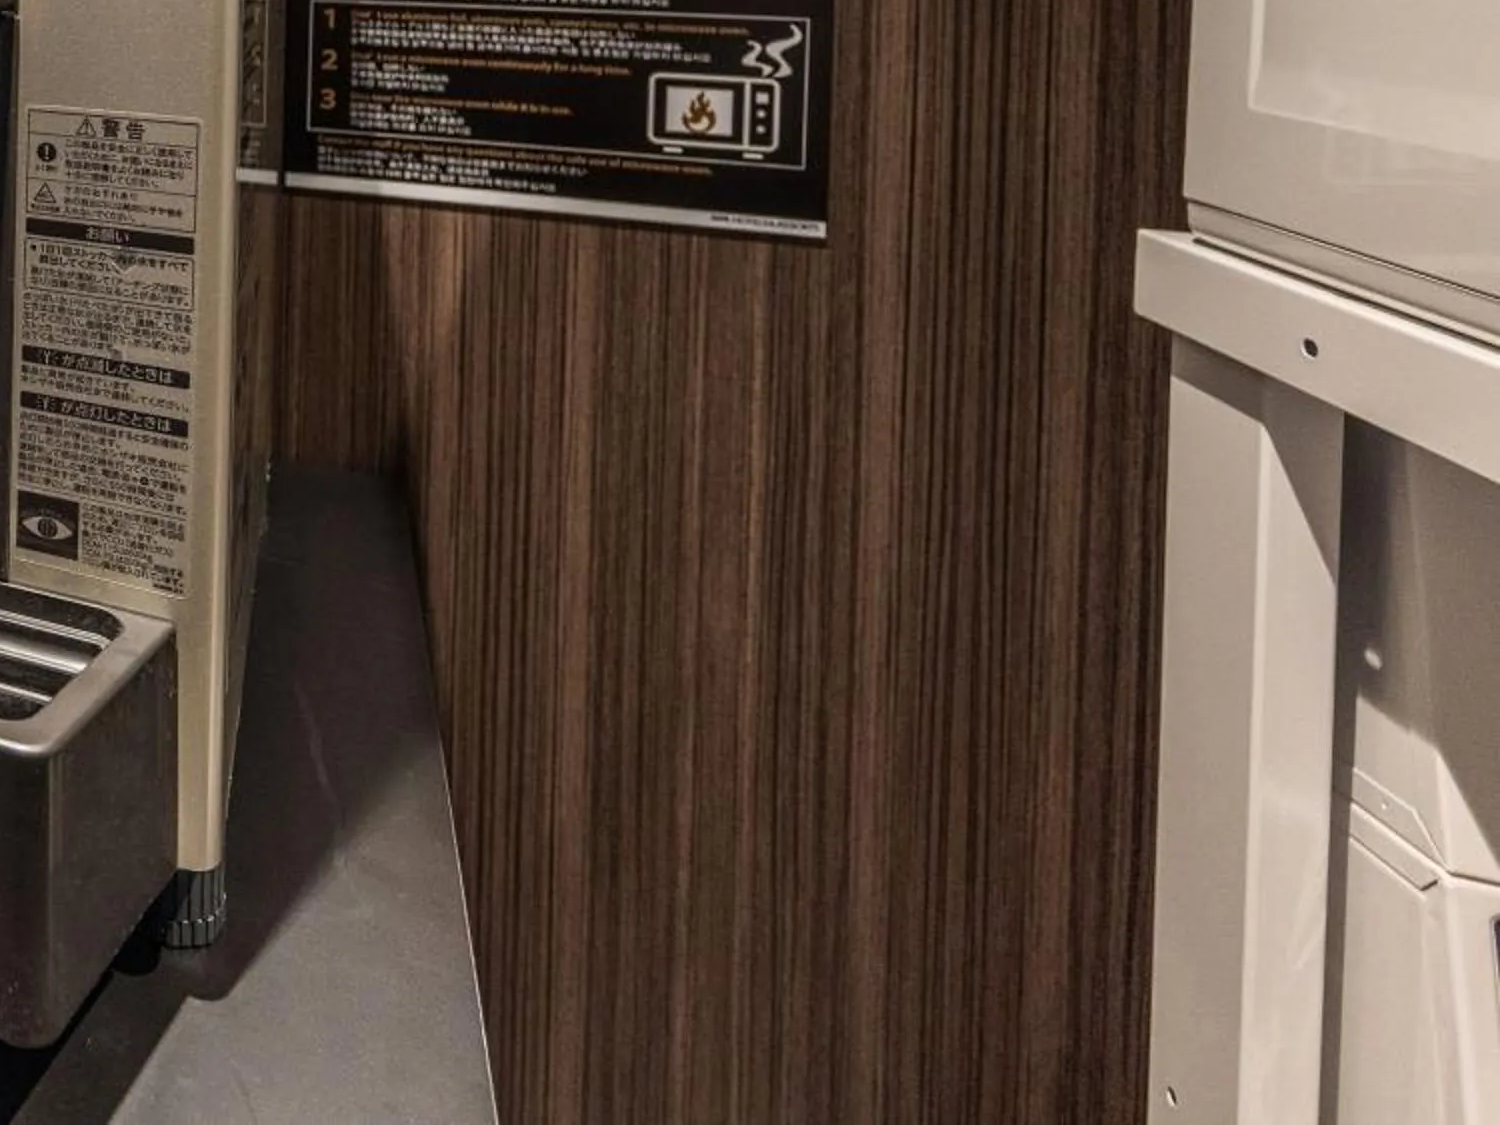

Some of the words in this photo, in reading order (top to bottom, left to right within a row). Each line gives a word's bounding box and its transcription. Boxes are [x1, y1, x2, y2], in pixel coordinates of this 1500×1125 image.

[323, 8, 336, 29] 1
[321, 49, 338, 70] 2
[319, 88, 336, 110] 3
